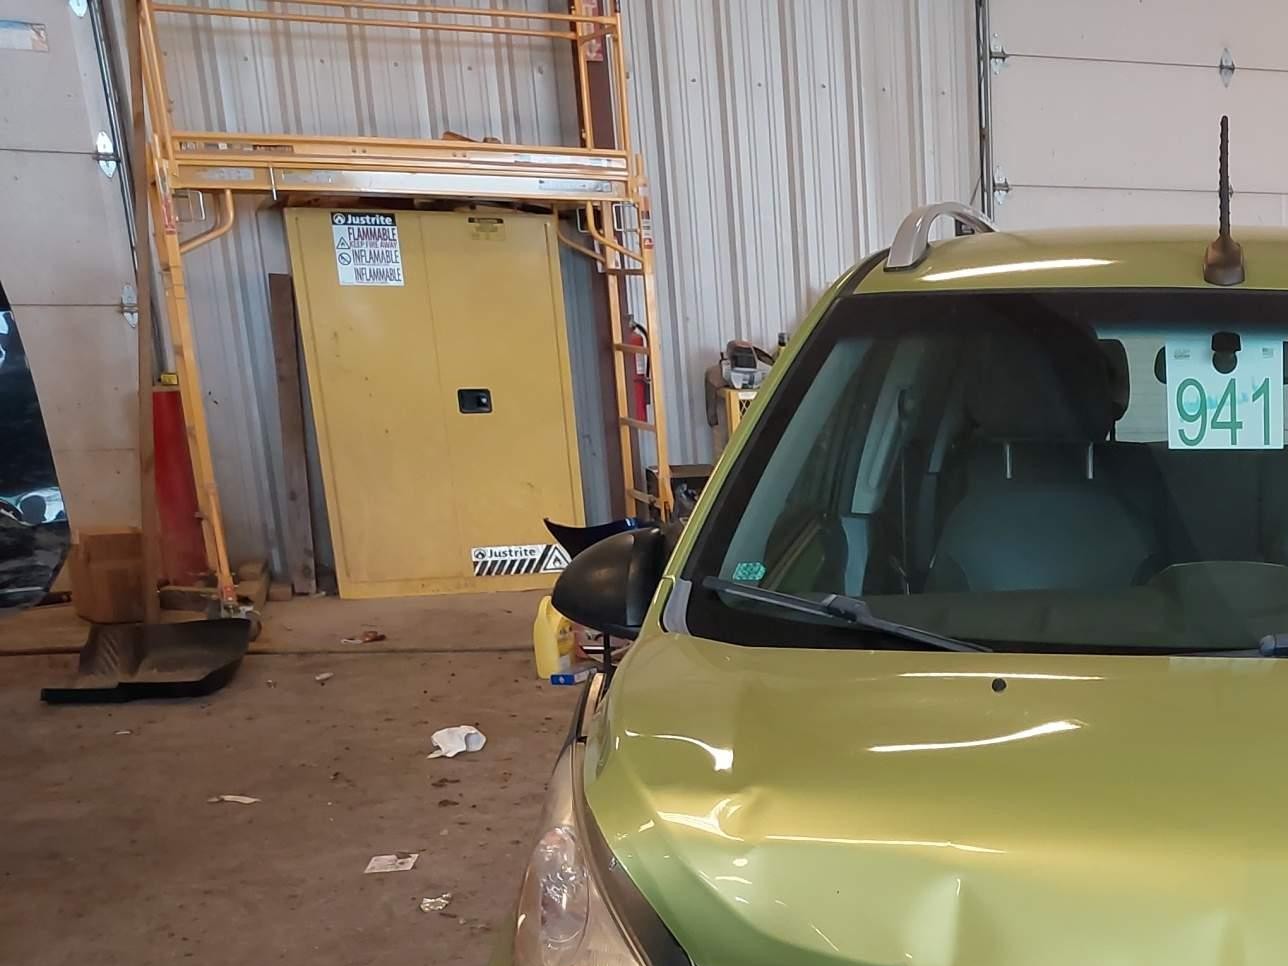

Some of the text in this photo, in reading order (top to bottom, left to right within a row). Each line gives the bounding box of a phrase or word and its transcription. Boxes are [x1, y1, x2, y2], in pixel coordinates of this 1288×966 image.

[347, 214, 393, 225] Justrite
[347, 227, 397, 242] FLAMMABLE
[352, 249, 400, 264] INFLAMABLE
[354, 267, 402, 282] INFLAMMABLE
[1176, 378, 1270, 447] 941
[488, 547, 537, 559] Justrite
